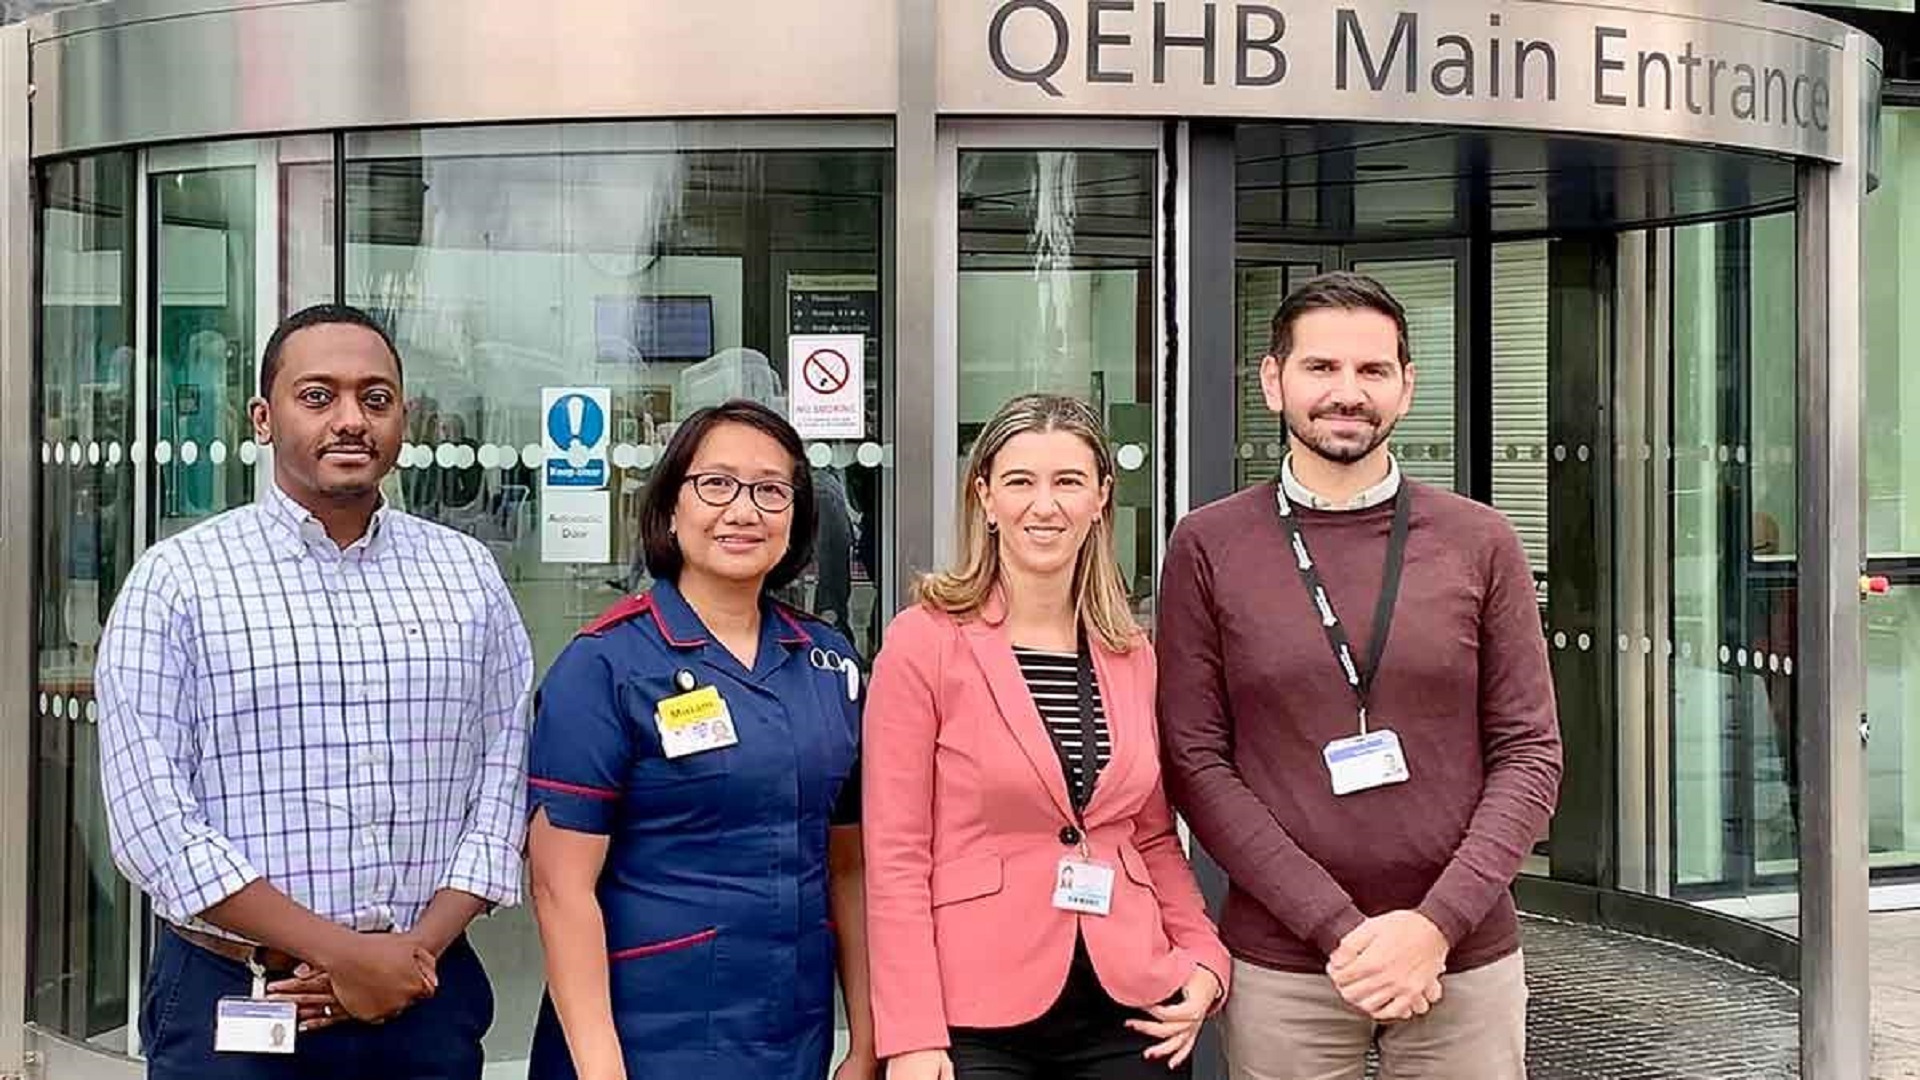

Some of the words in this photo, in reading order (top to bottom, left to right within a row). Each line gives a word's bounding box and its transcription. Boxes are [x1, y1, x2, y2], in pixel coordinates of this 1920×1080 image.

[988, 0, 1287, 97] QEHB
[1335, 8, 1556, 101] Main
[1594, 25, 1830, 131] Entrance
[561, 527, 588, 539] Door
